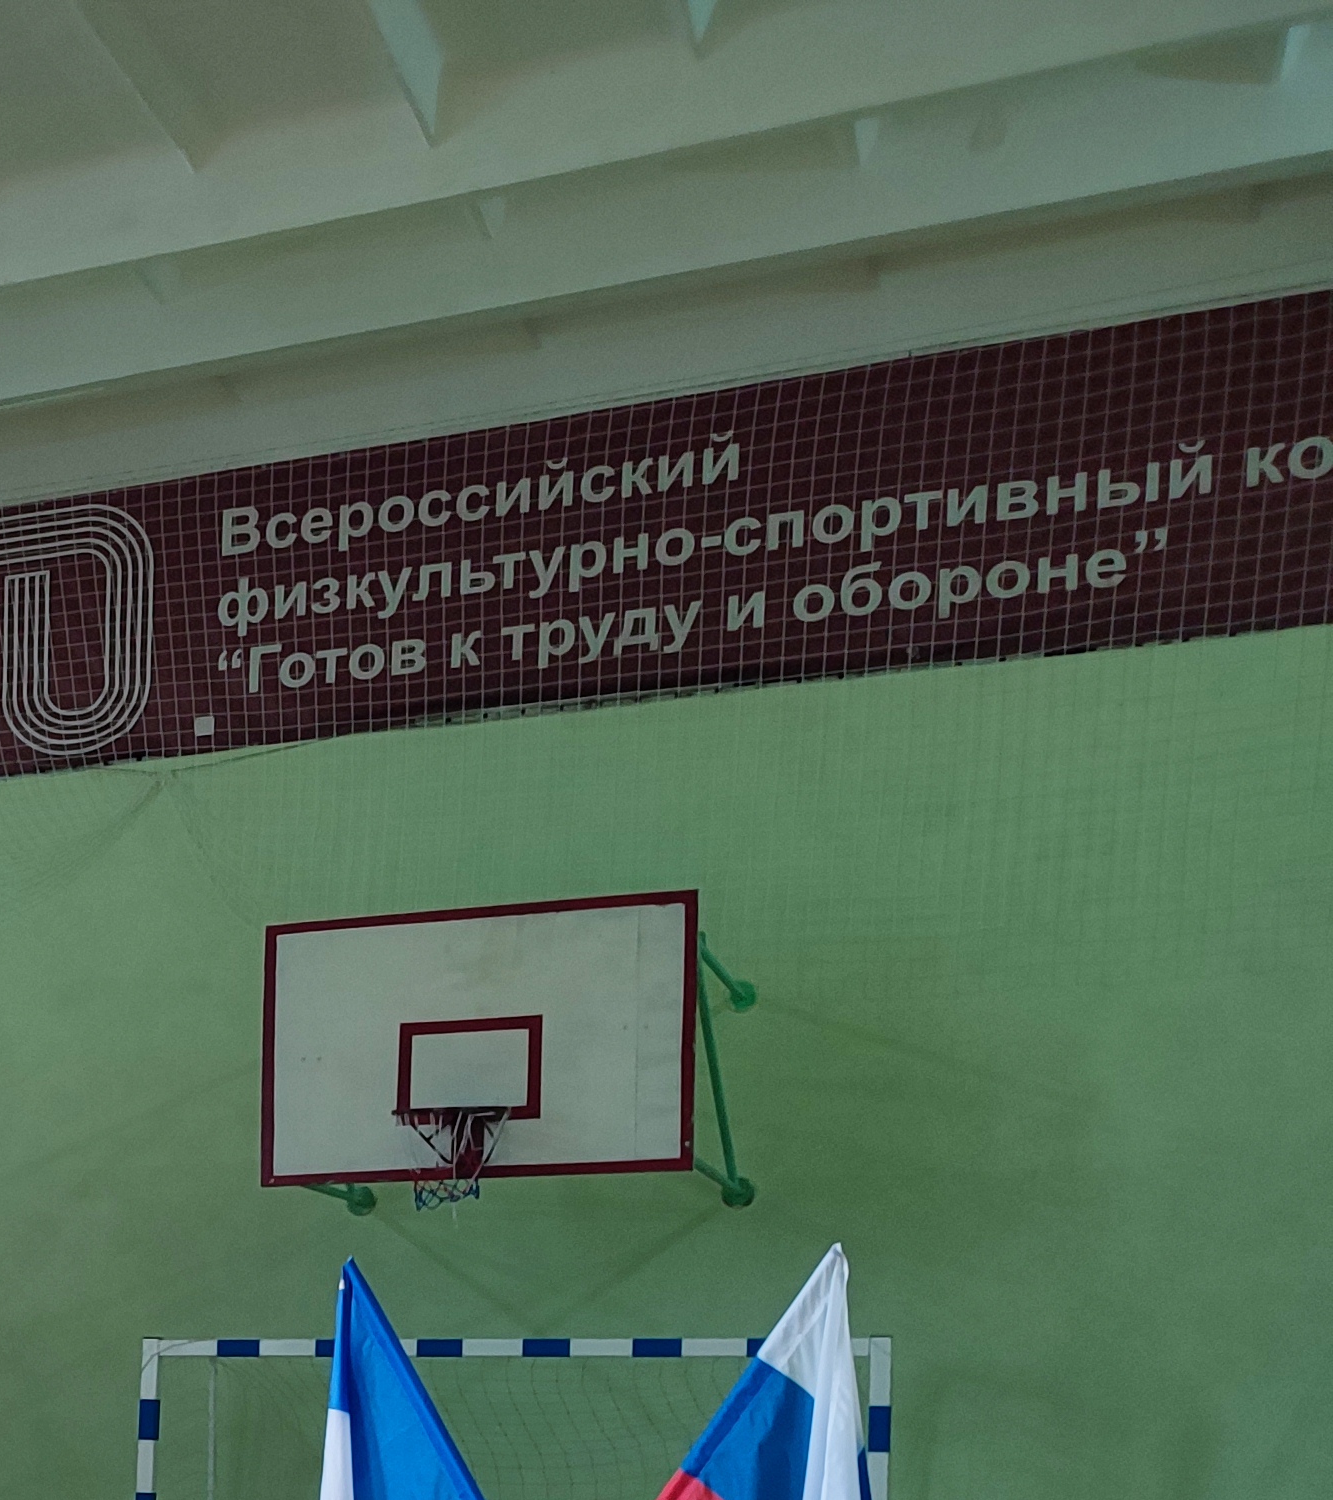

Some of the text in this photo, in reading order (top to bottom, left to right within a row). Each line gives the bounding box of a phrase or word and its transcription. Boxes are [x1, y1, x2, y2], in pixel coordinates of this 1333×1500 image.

[217, 435, 1333, 637] физкультурно-спортивный ко
[221, 430, 741, 557] Всероссийский
[217, 526, 1169, 694] “Готов к труду и обороне”
